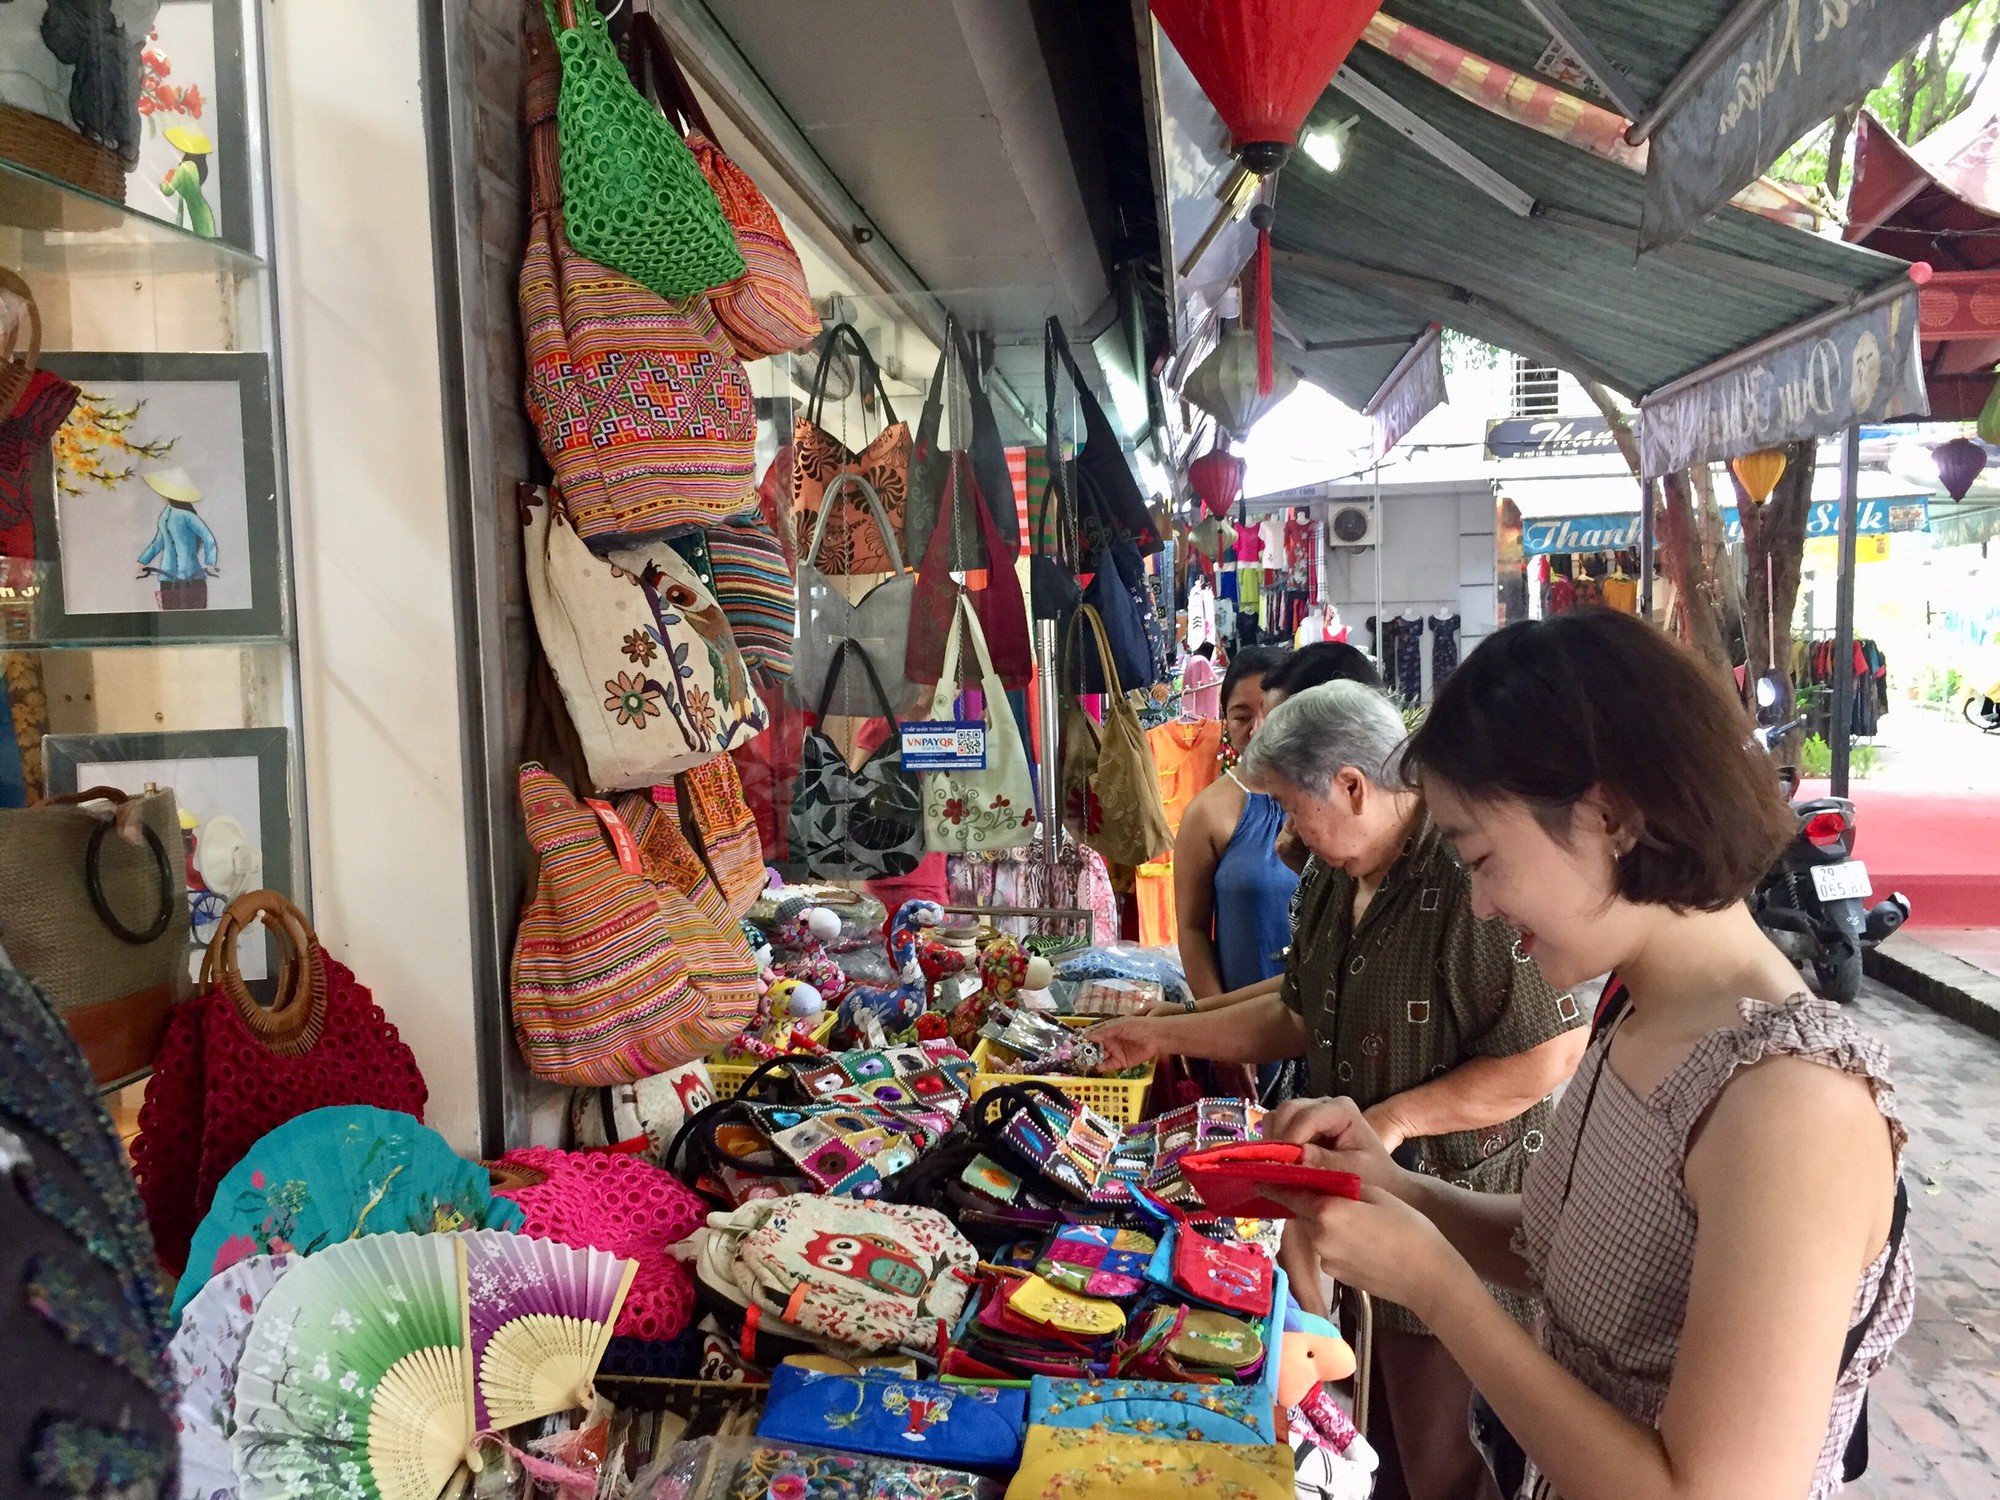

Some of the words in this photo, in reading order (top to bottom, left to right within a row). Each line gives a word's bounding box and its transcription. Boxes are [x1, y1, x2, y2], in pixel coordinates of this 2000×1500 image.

[1530, 419, 1636, 450] Than
[1806, 500, 1886, 533] Sk
[907, 737, 953, 748] VNPAYQR
